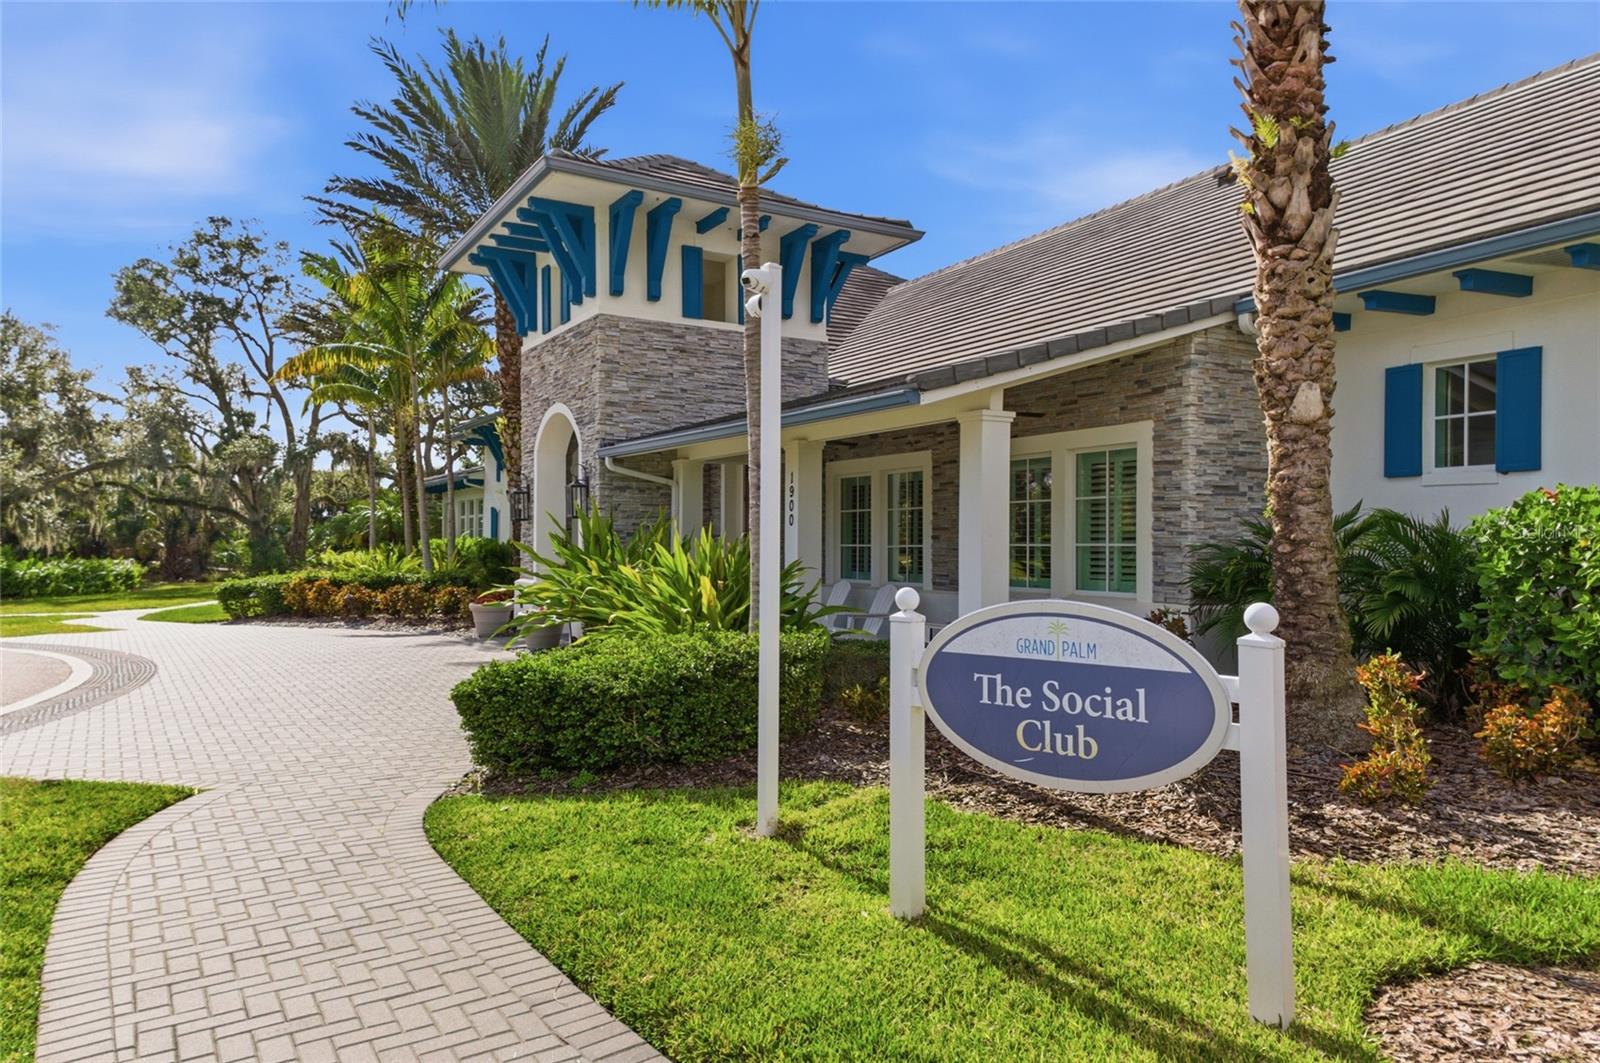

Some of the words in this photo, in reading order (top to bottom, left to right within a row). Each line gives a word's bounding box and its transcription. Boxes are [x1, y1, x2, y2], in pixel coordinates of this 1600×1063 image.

[1016, 637, 1055, 656] GRAND
[1061, 640, 1097, 660] PALM
[973, 672, 1032, 709] The
[1042, 680, 1149, 724] Social
[1016, 719, 1098, 760] Club
